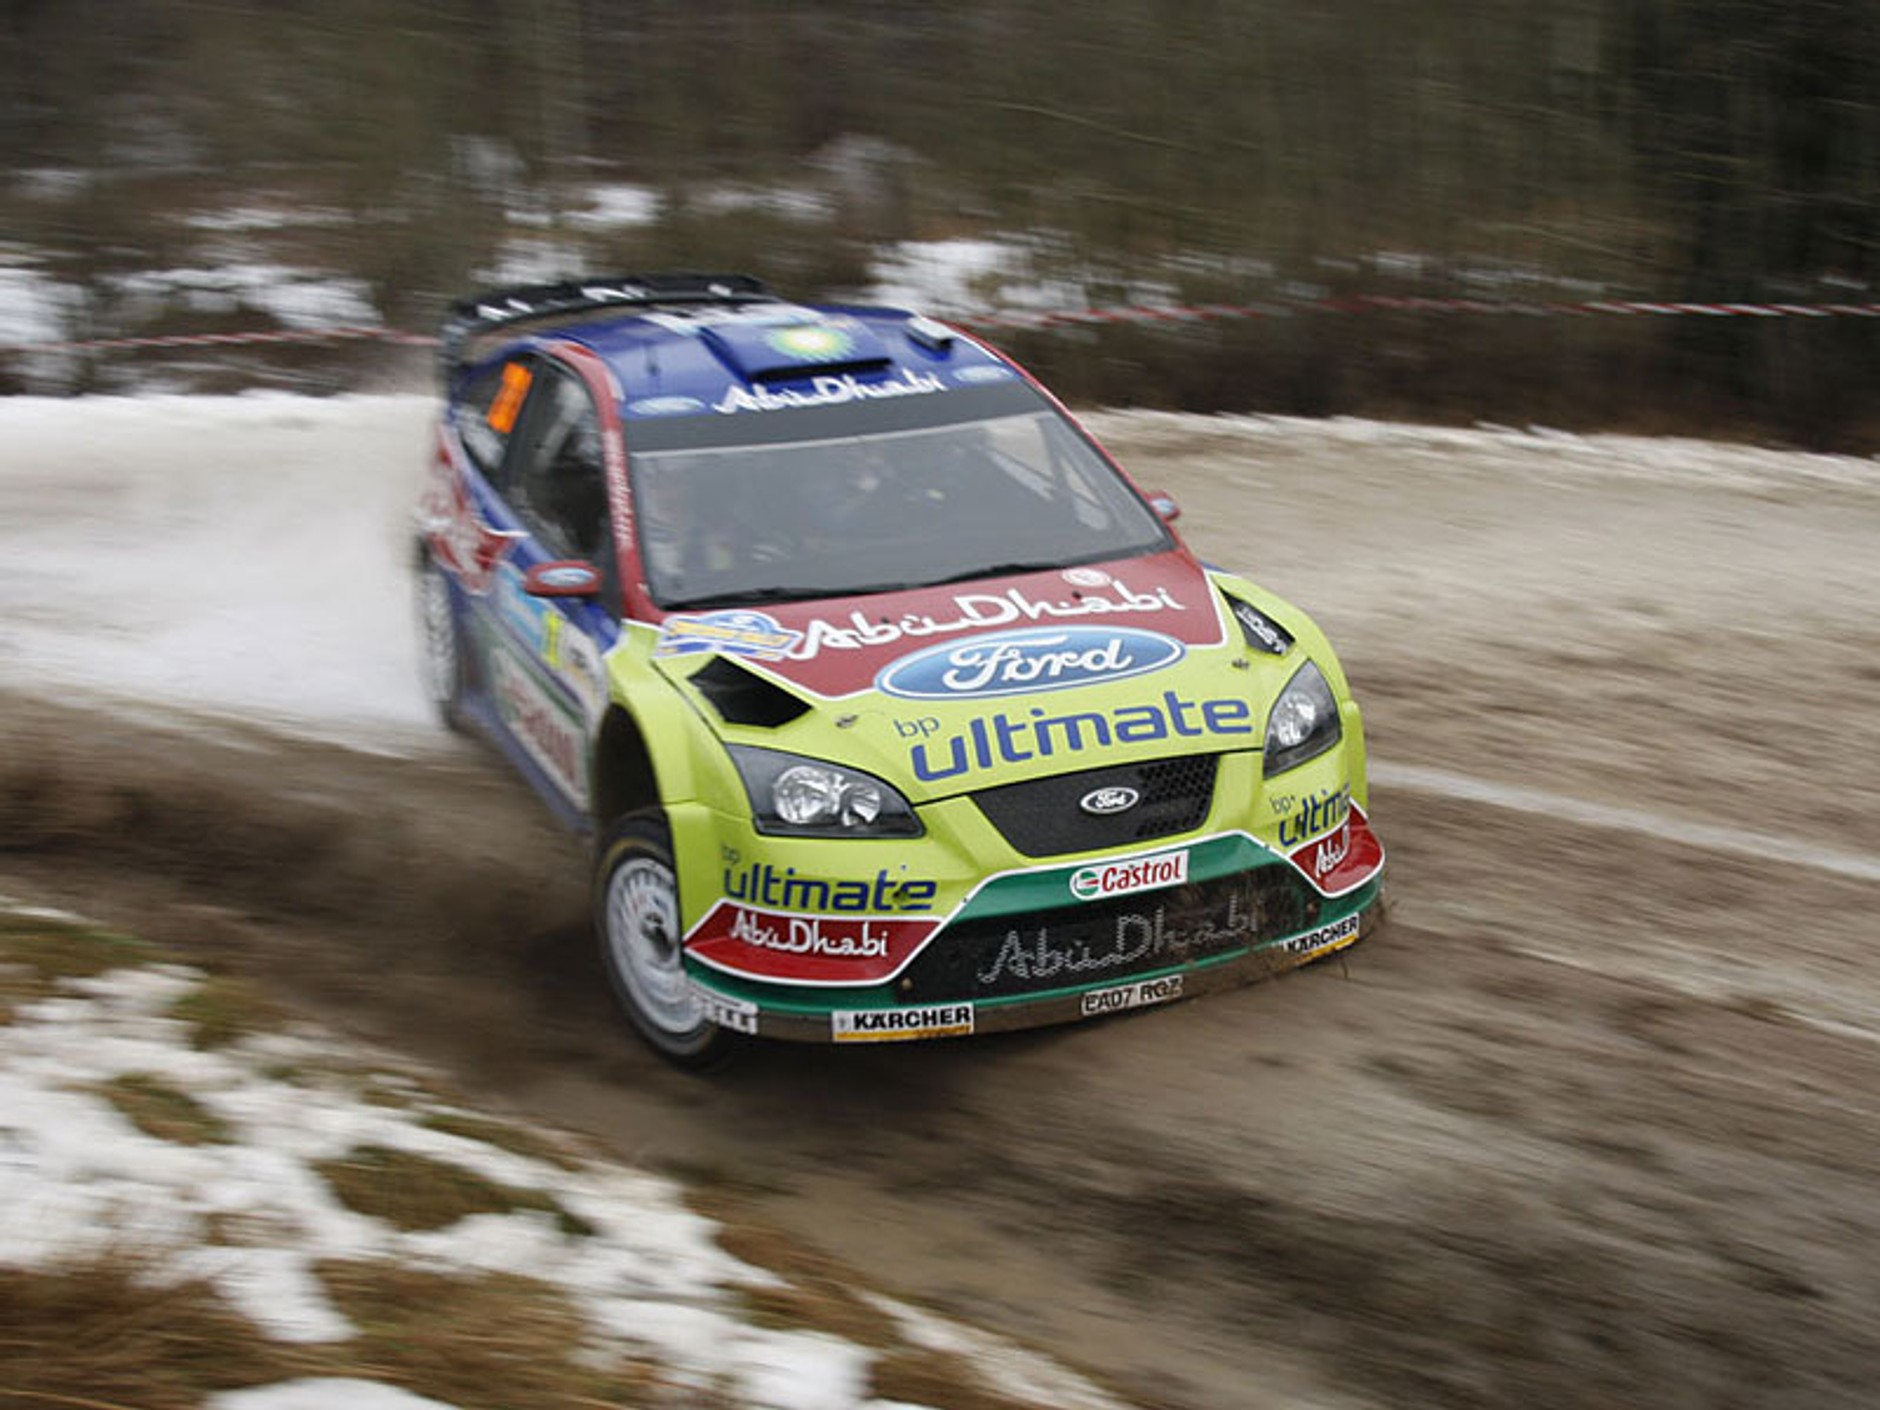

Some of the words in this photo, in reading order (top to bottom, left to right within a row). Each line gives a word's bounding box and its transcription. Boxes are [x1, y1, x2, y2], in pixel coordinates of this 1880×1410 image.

[943, 634, 1132, 691] Ford
[893, 716, 940, 738] bp
[911, 691, 1253, 782] ultimate
[724, 863, 937, 910] ultimate
[1102, 856, 1180, 892] Castrol
